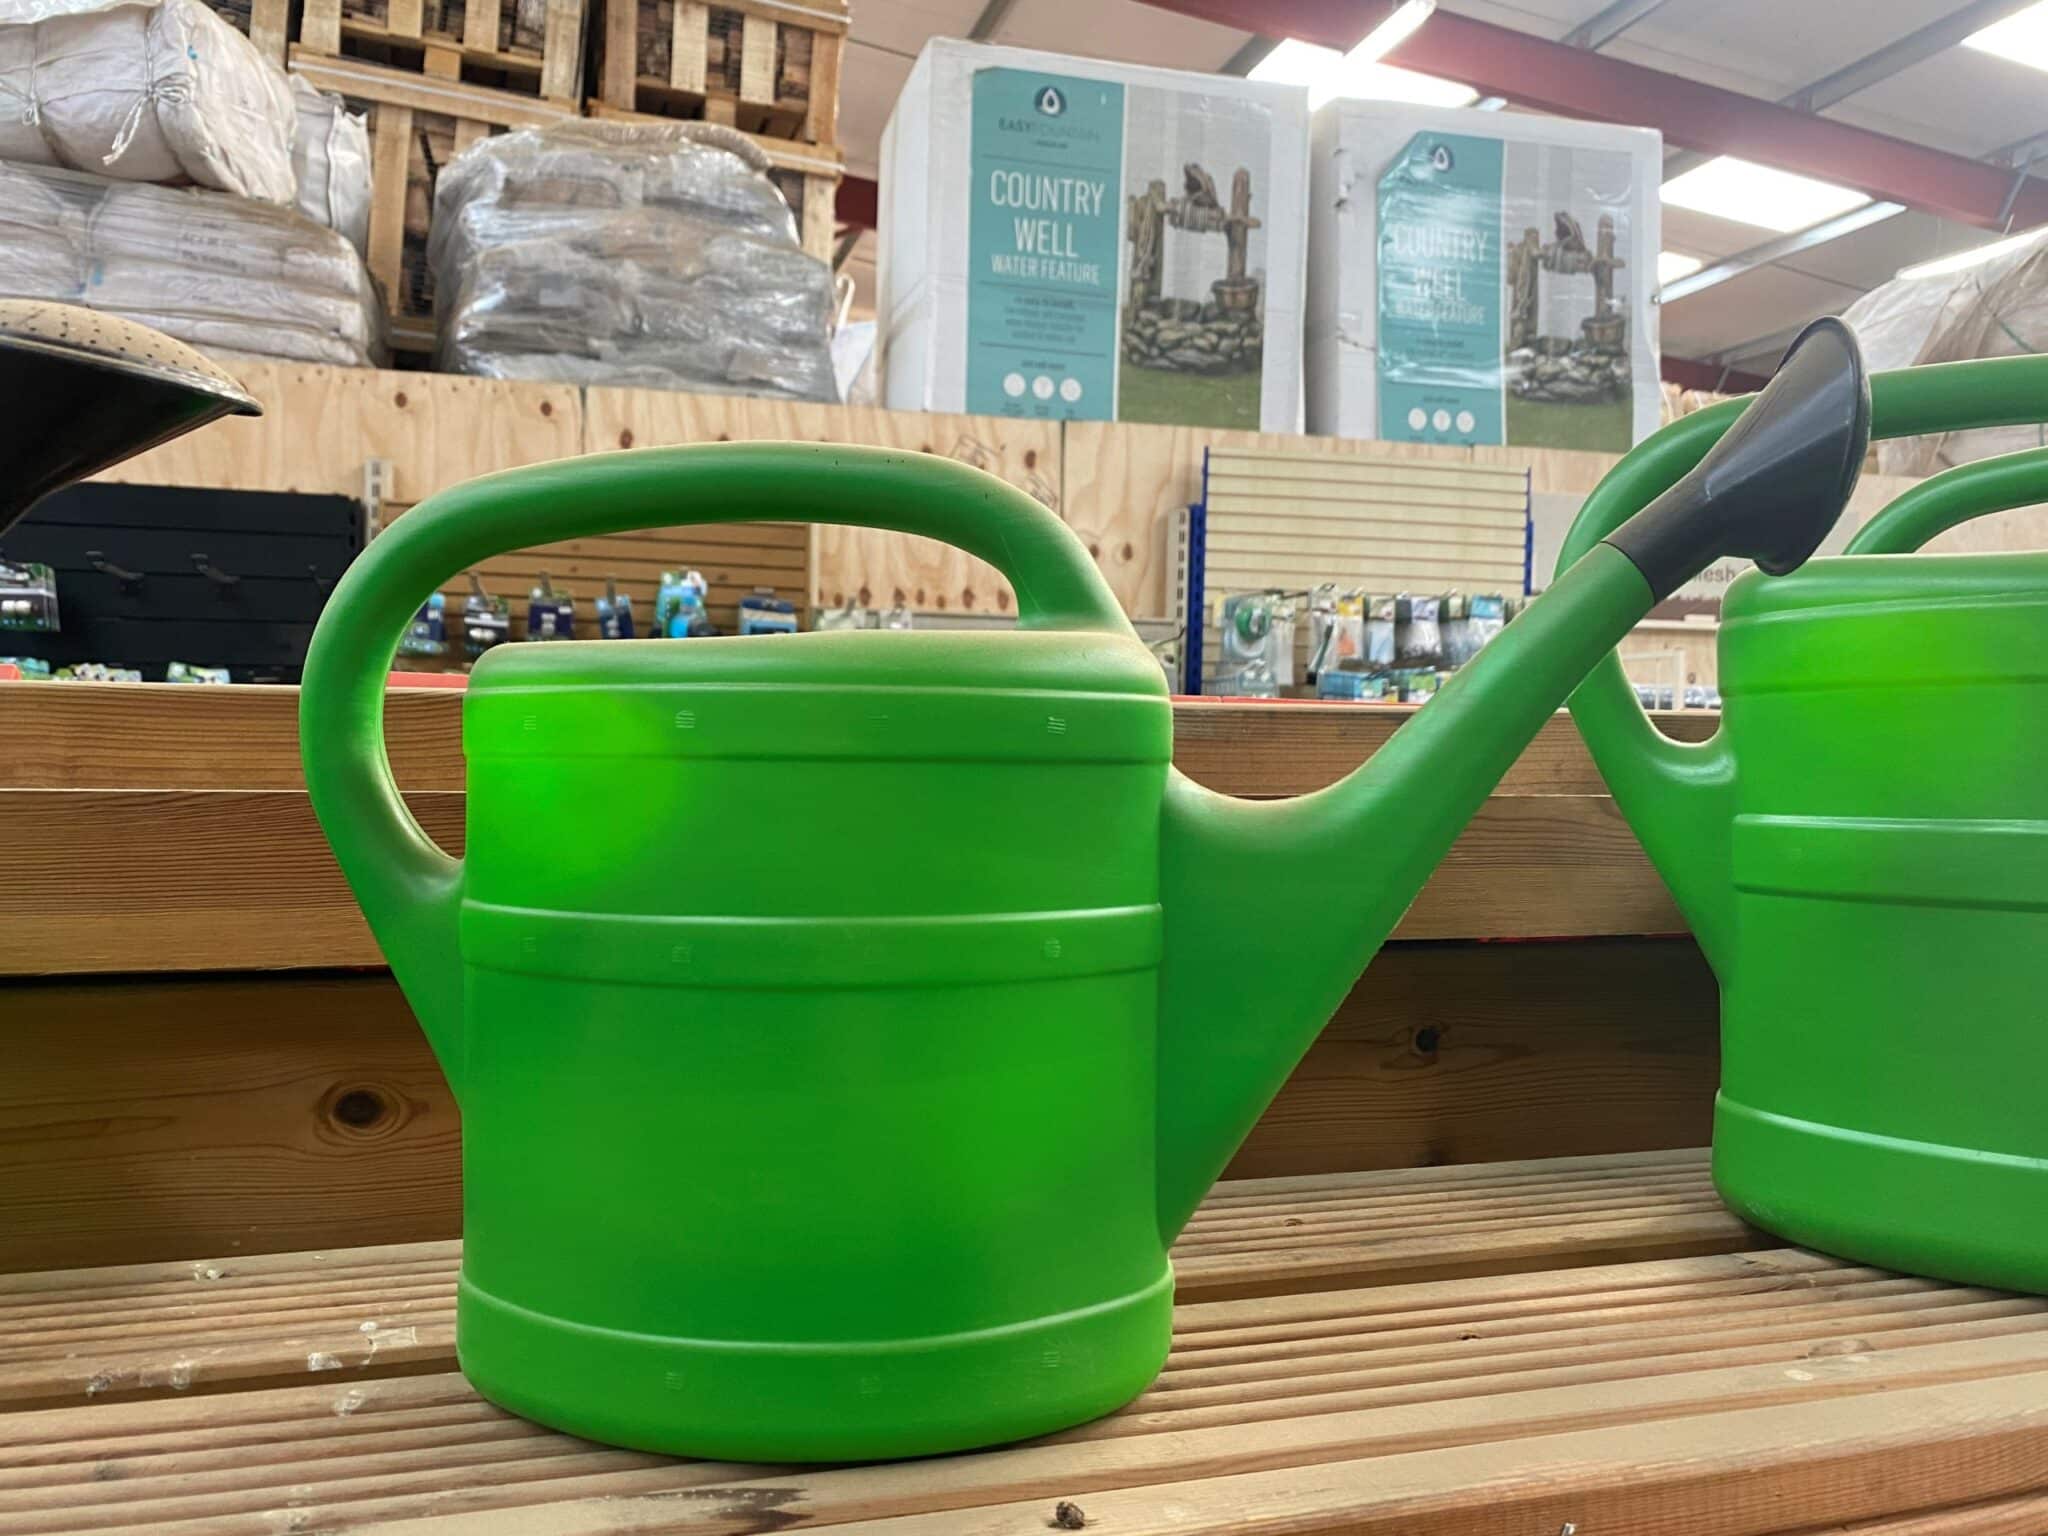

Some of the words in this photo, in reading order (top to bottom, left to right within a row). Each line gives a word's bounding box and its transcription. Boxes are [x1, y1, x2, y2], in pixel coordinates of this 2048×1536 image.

[990, 169, 1105, 216] COUNTRY
[1014, 216, 1078, 257] WELL
[991, 254, 1038, 279] WATER
[1040, 259, 1099, 285] FEATURE
